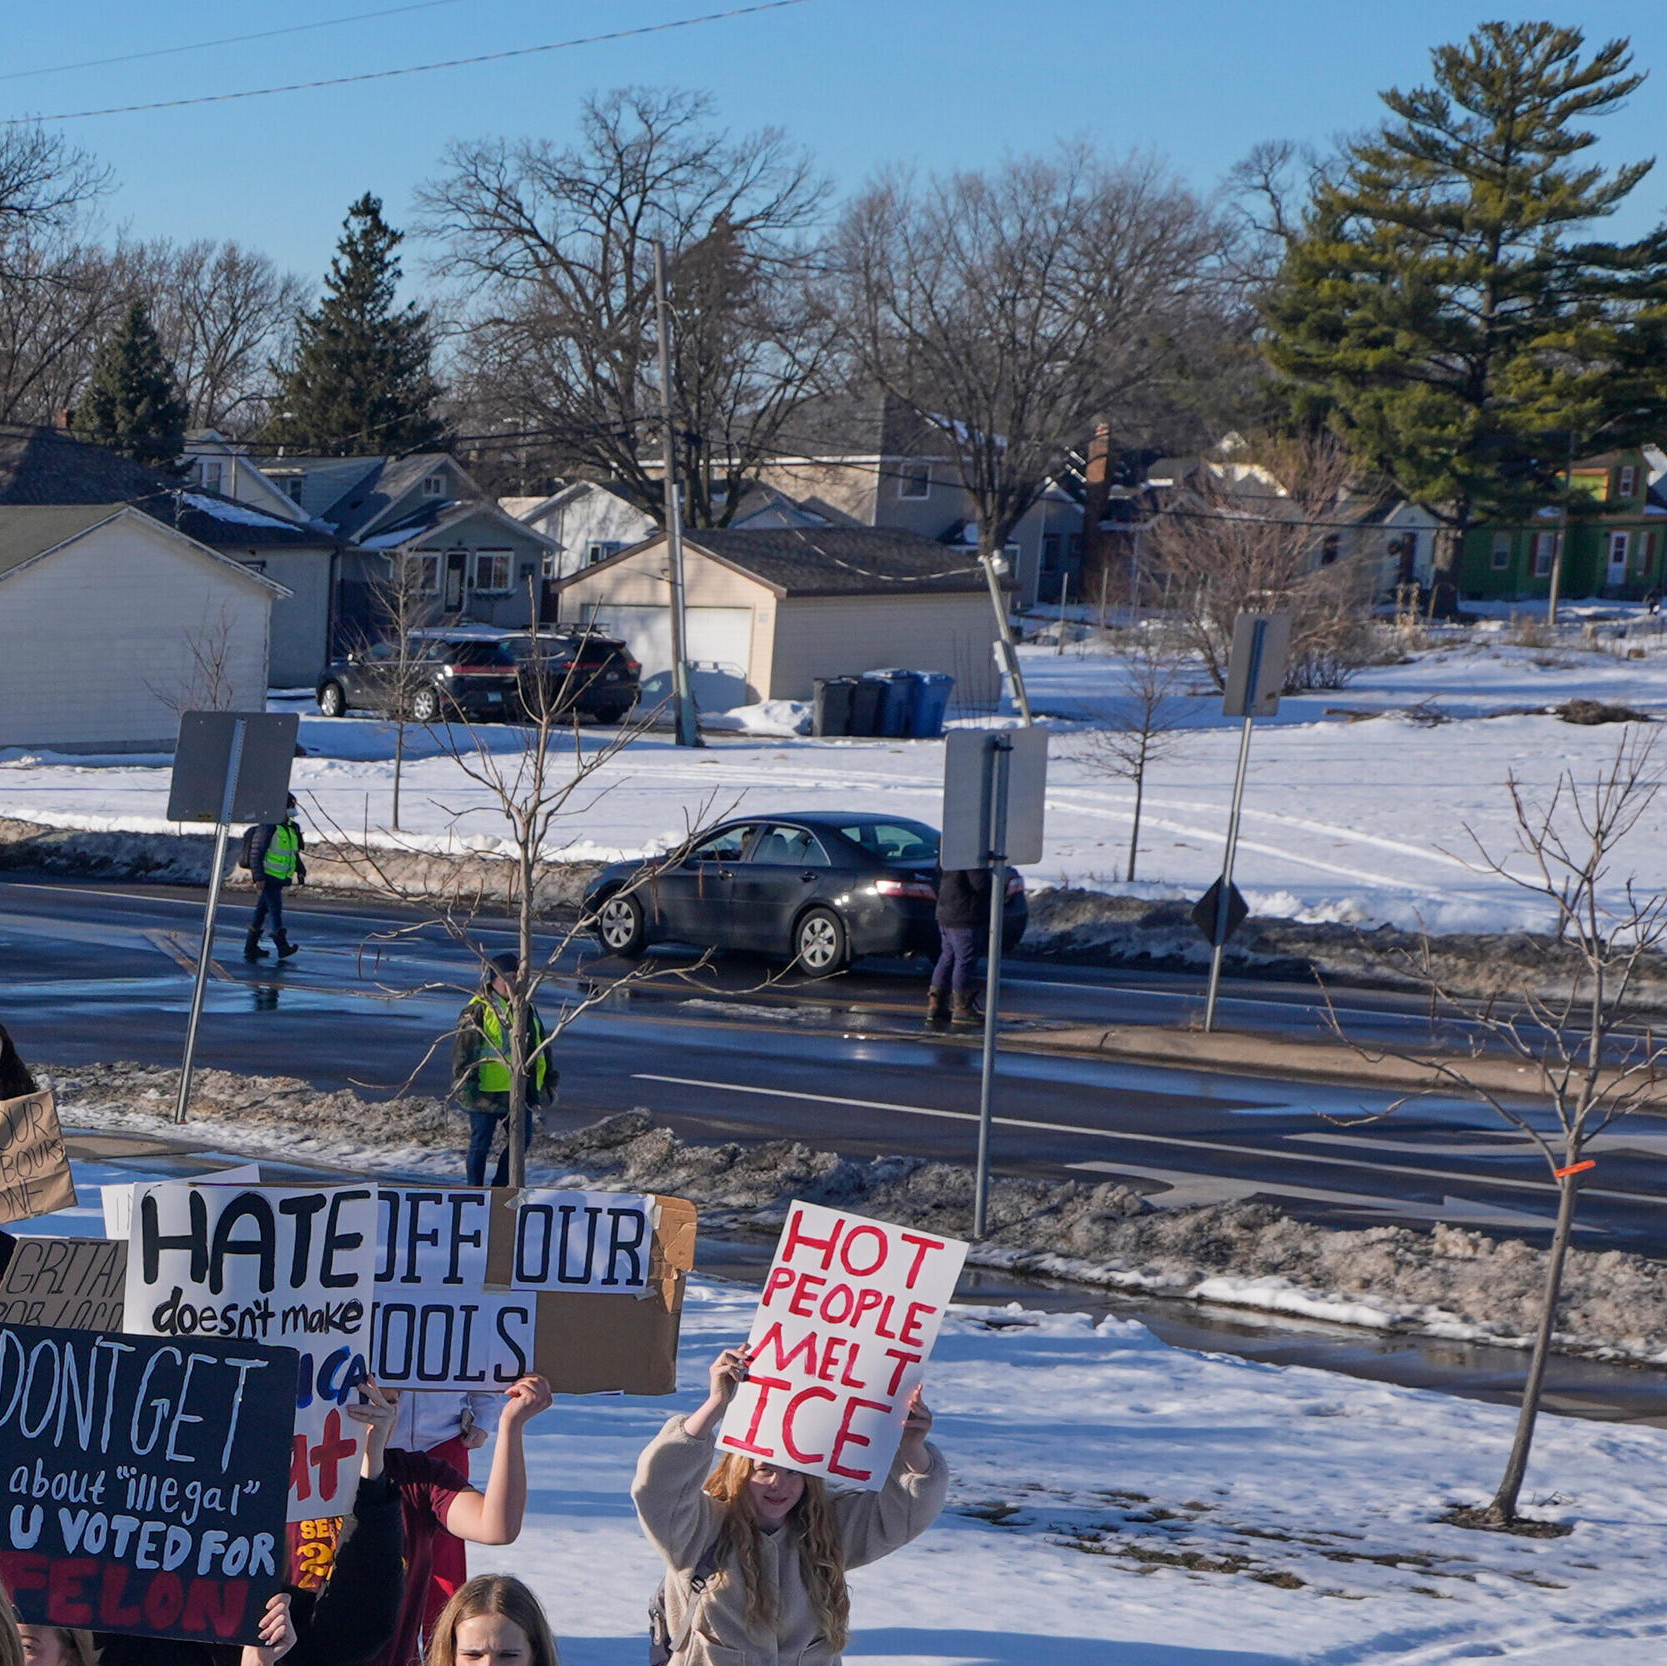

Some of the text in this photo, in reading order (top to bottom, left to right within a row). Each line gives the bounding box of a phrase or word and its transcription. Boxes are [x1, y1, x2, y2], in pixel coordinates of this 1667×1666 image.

[141, 1188, 372, 1295] HATE
[515, 1203, 645, 1287] OUR
[782, 1209, 945, 1289] HOT
[152, 1286, 275, 1345] doesn't
[281, 1297, 364, 1337] make
[370, 1302, 529, 1383] OOLS
[762, 1266, 937, 1348] PEOPLE
[742, 1321, 922, 1397] MELT
[130, 1344, 270, 1474] GET
[722, 1374, 893, 1482] ICE
[8, 1457, 106, 1506] about
[9, 1504, 44, 1550] U
[58, 1508, 192, 1572] VOTED
[197, 1530, 276, 1577] FOR
